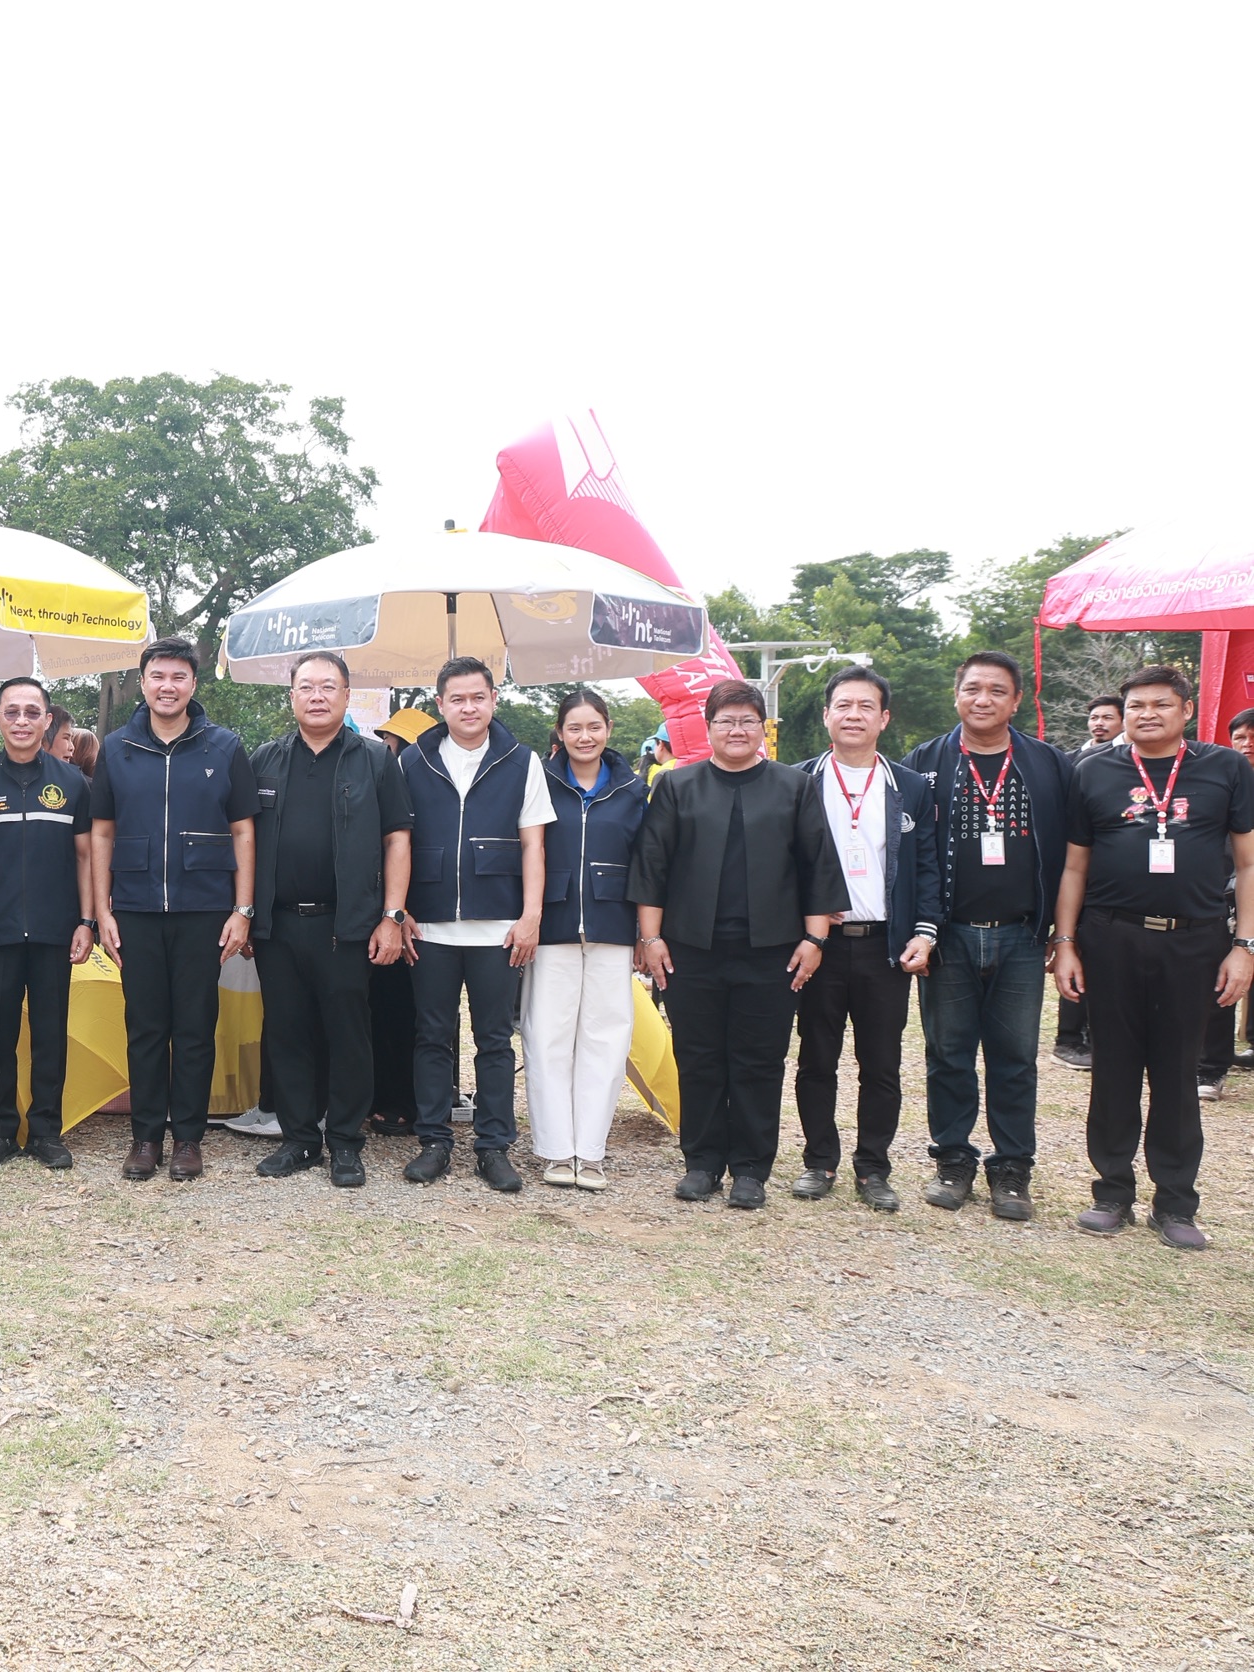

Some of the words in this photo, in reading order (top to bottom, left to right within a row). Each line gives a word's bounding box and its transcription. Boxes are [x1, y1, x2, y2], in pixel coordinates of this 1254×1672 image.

[10, 605, 35, 619] Next,
[38, 608, 78, 624] through
[82, 613, 142, 630] Technology
[312, 626, 336, 634] National
